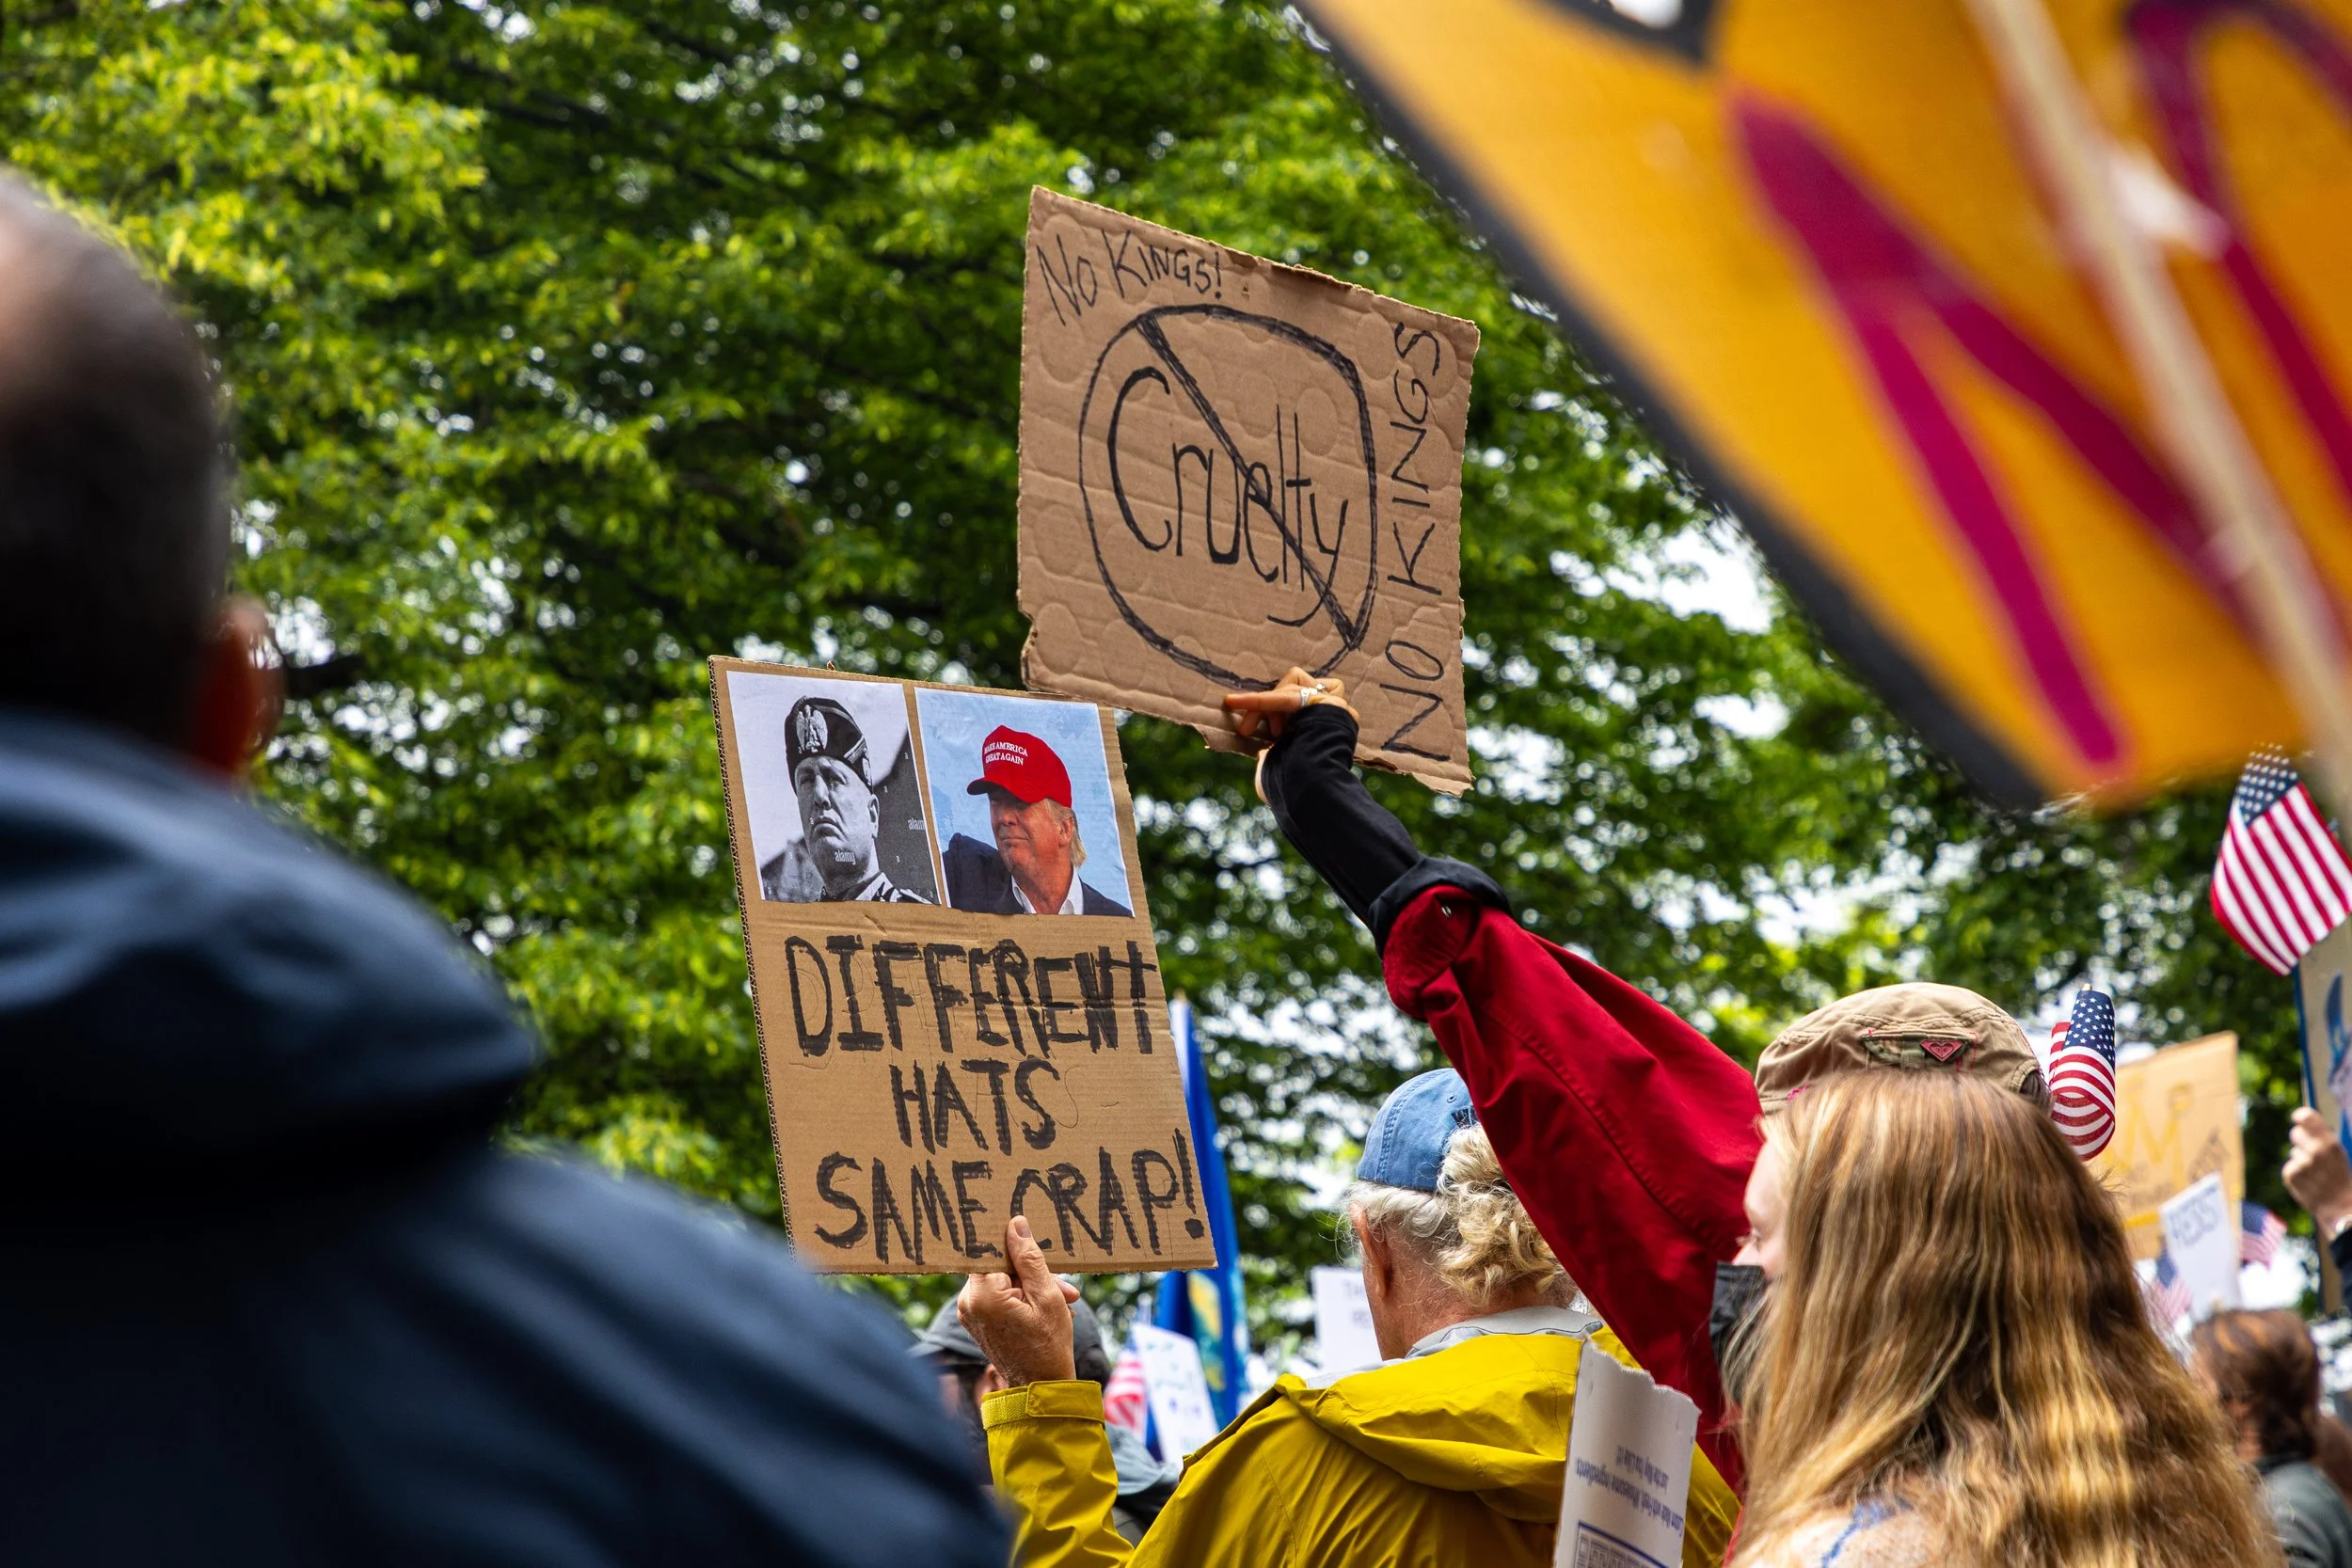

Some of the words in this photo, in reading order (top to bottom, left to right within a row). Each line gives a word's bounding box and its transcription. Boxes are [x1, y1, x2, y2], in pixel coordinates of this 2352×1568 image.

[1036, 234, 1098, 326] No
[1107, 366, 1349, 627] Cruelty
[1390, 322, 1441, 596] KINGS
[995, 741, 1028, 756] AMERICA
[1380, 640, 1451, 763] NO
[1000, 752, 1024, 766] AGAIN
[834, 849, 856, 865] alamy
[785, 934, 1157, 1057] DIFFERENT
[889, 1055, 1060, 1156] HATS
[815, 1150, 1003, 1265] SAME
[1009, 1128, 1205, 1257] CRAP!
